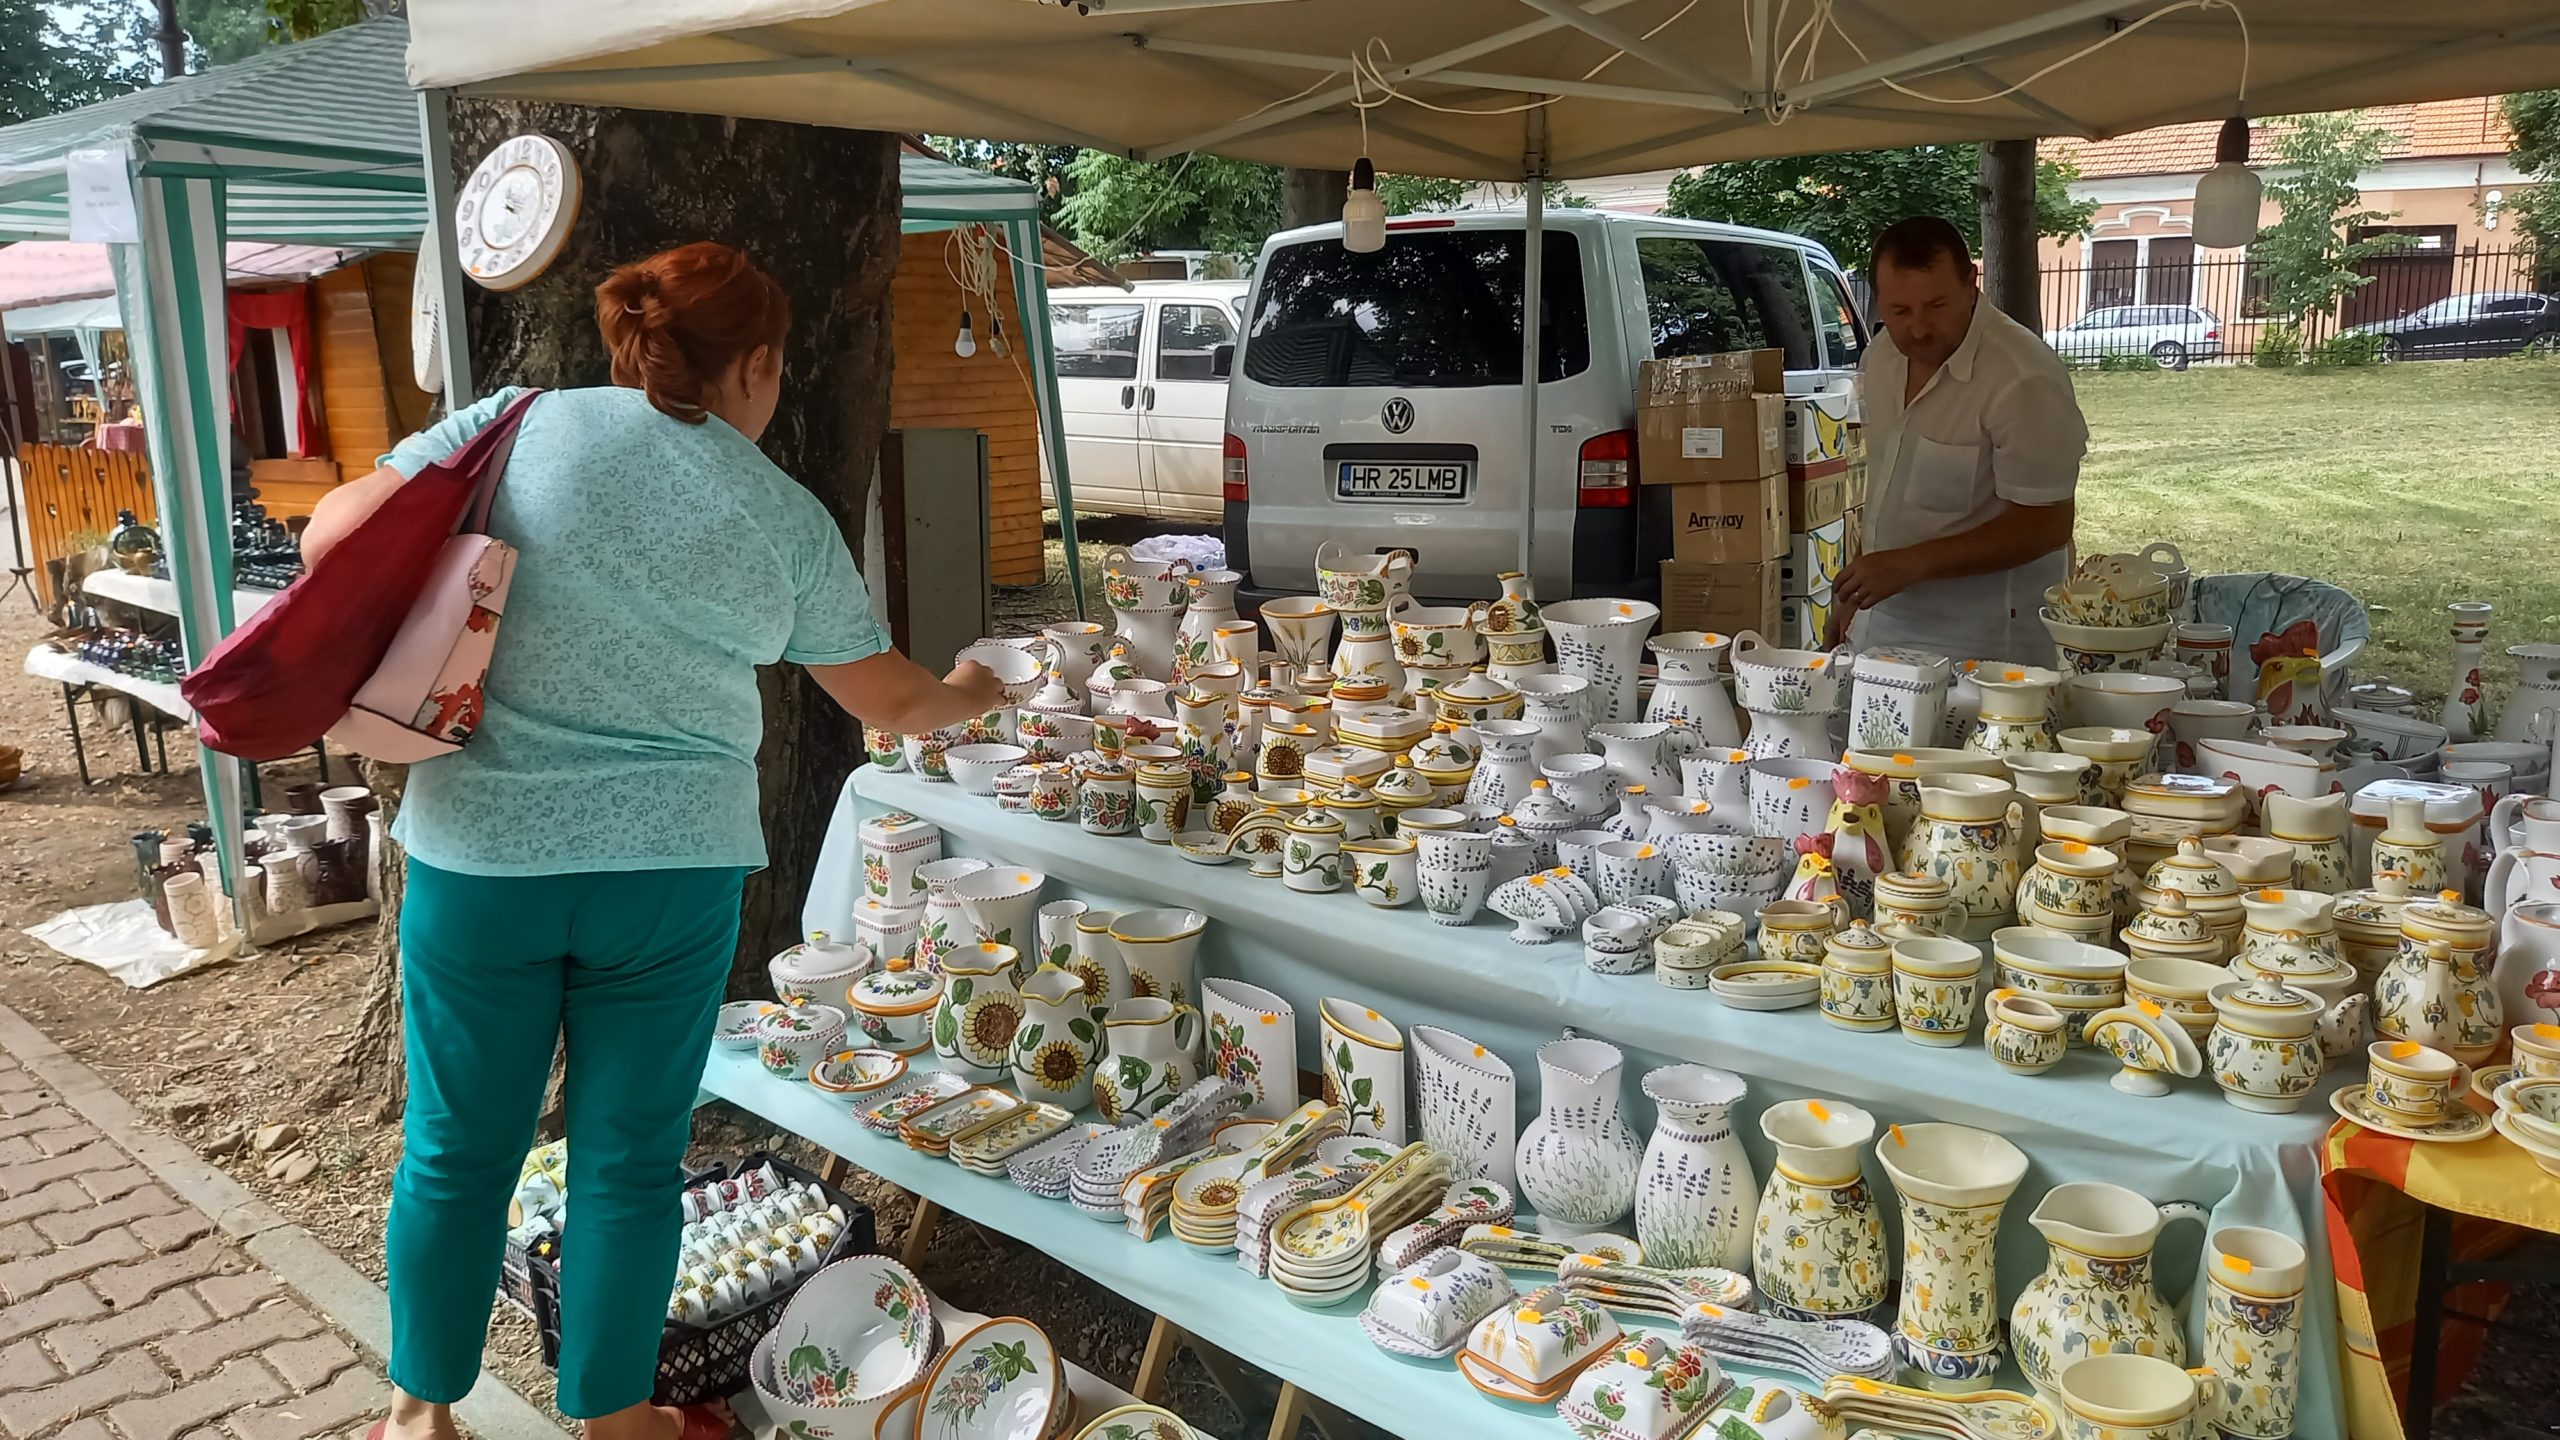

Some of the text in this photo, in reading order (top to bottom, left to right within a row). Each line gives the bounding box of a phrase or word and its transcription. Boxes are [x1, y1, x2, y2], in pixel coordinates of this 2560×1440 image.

[472, 170, 491, 193] 10
[462, 200, 475, 222] 9
[461, 226, 473, 248] 8
[1352, 468, 1457, 490] HR 25 LMB
[1688, 512, 1744, 529] Amway
